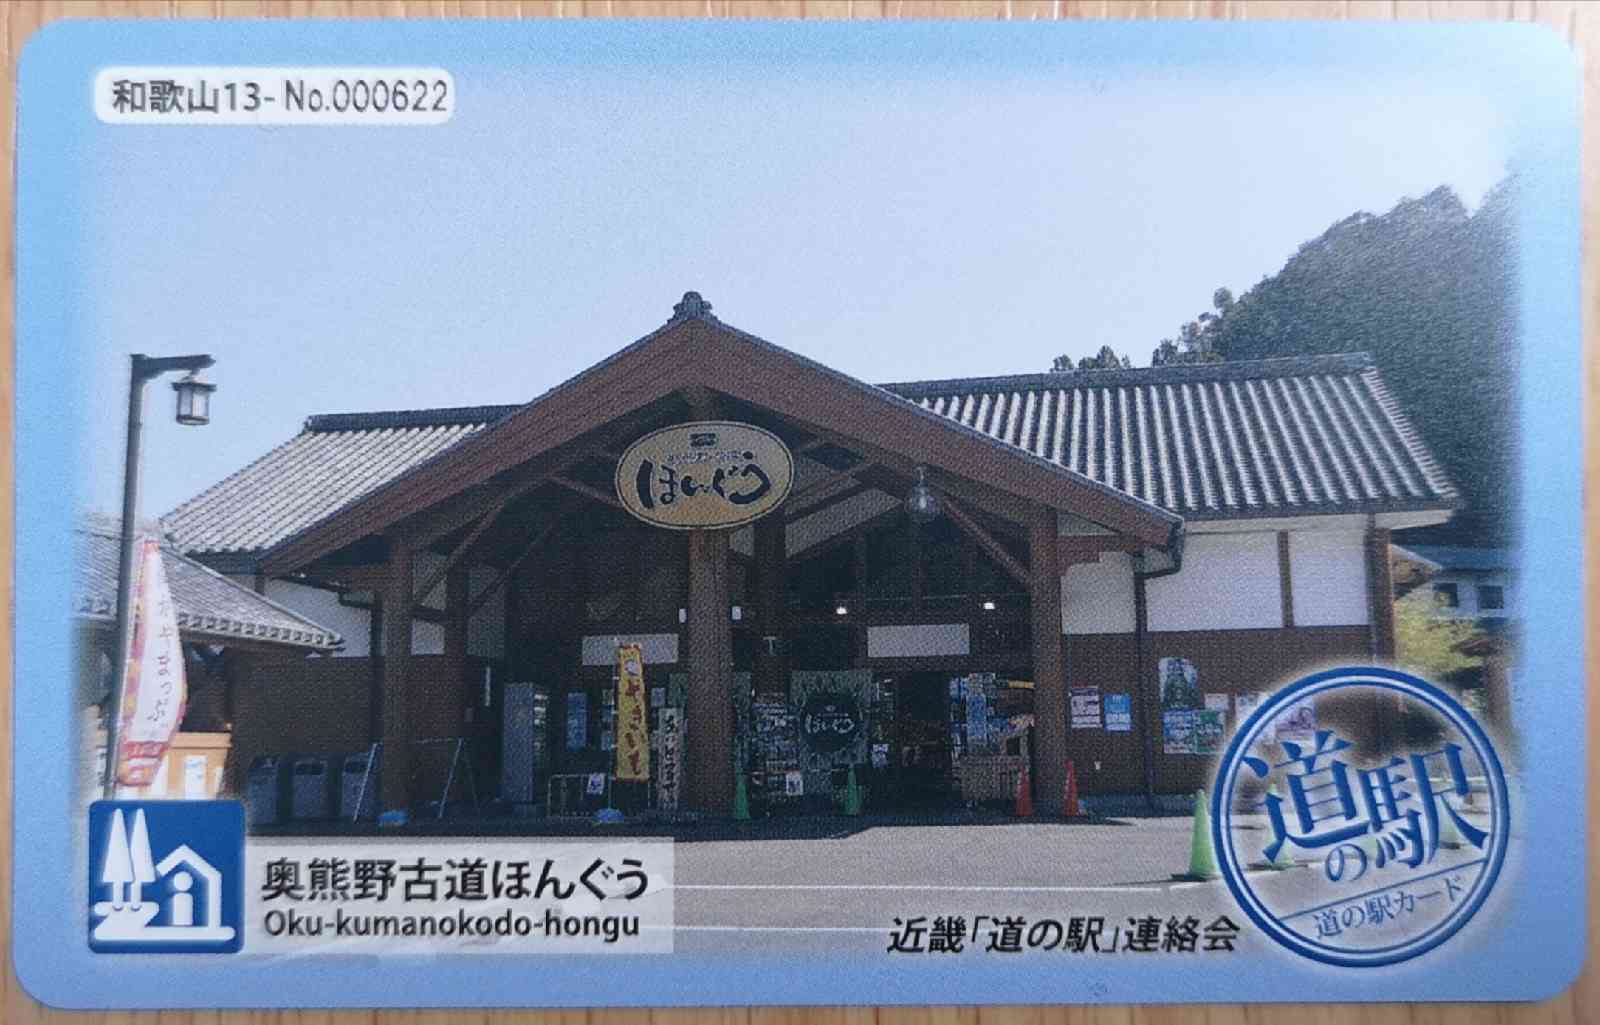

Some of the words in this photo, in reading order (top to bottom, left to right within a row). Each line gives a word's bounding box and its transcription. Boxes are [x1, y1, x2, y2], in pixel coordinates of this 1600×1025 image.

[284, 79, 449, 112] No.000622
[1240, 730, 1489, 882] 道の駅
[261, 857, 649, 902] 奥熊野古道ほんぐう
[264, 908, 641, 943] Oku-kumanokodo-hongu
[1313, 873, 1465, 939] 道の駅カード
[886, 915, 1241, 954] 近畿「道の駅」連絡会
